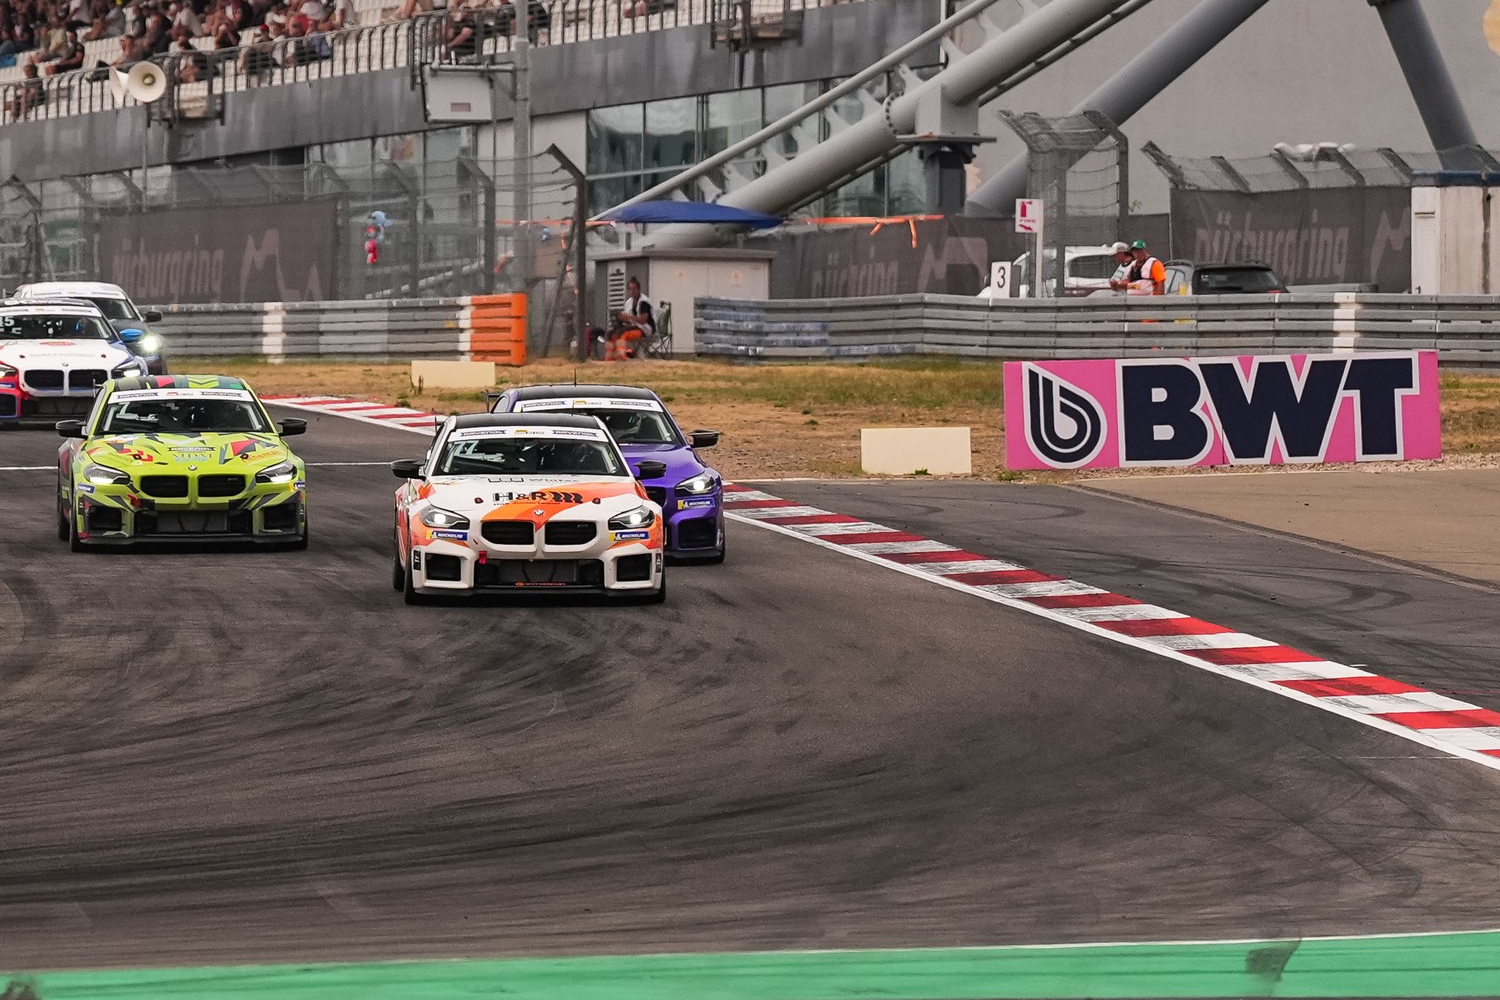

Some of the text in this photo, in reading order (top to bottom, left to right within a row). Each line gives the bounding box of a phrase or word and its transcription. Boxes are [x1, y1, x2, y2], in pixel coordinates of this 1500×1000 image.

[997, 266, 1006, 289] 3
[1121, 357, 1414, 461] BWT
[493, 491, 549, 503] H&R
